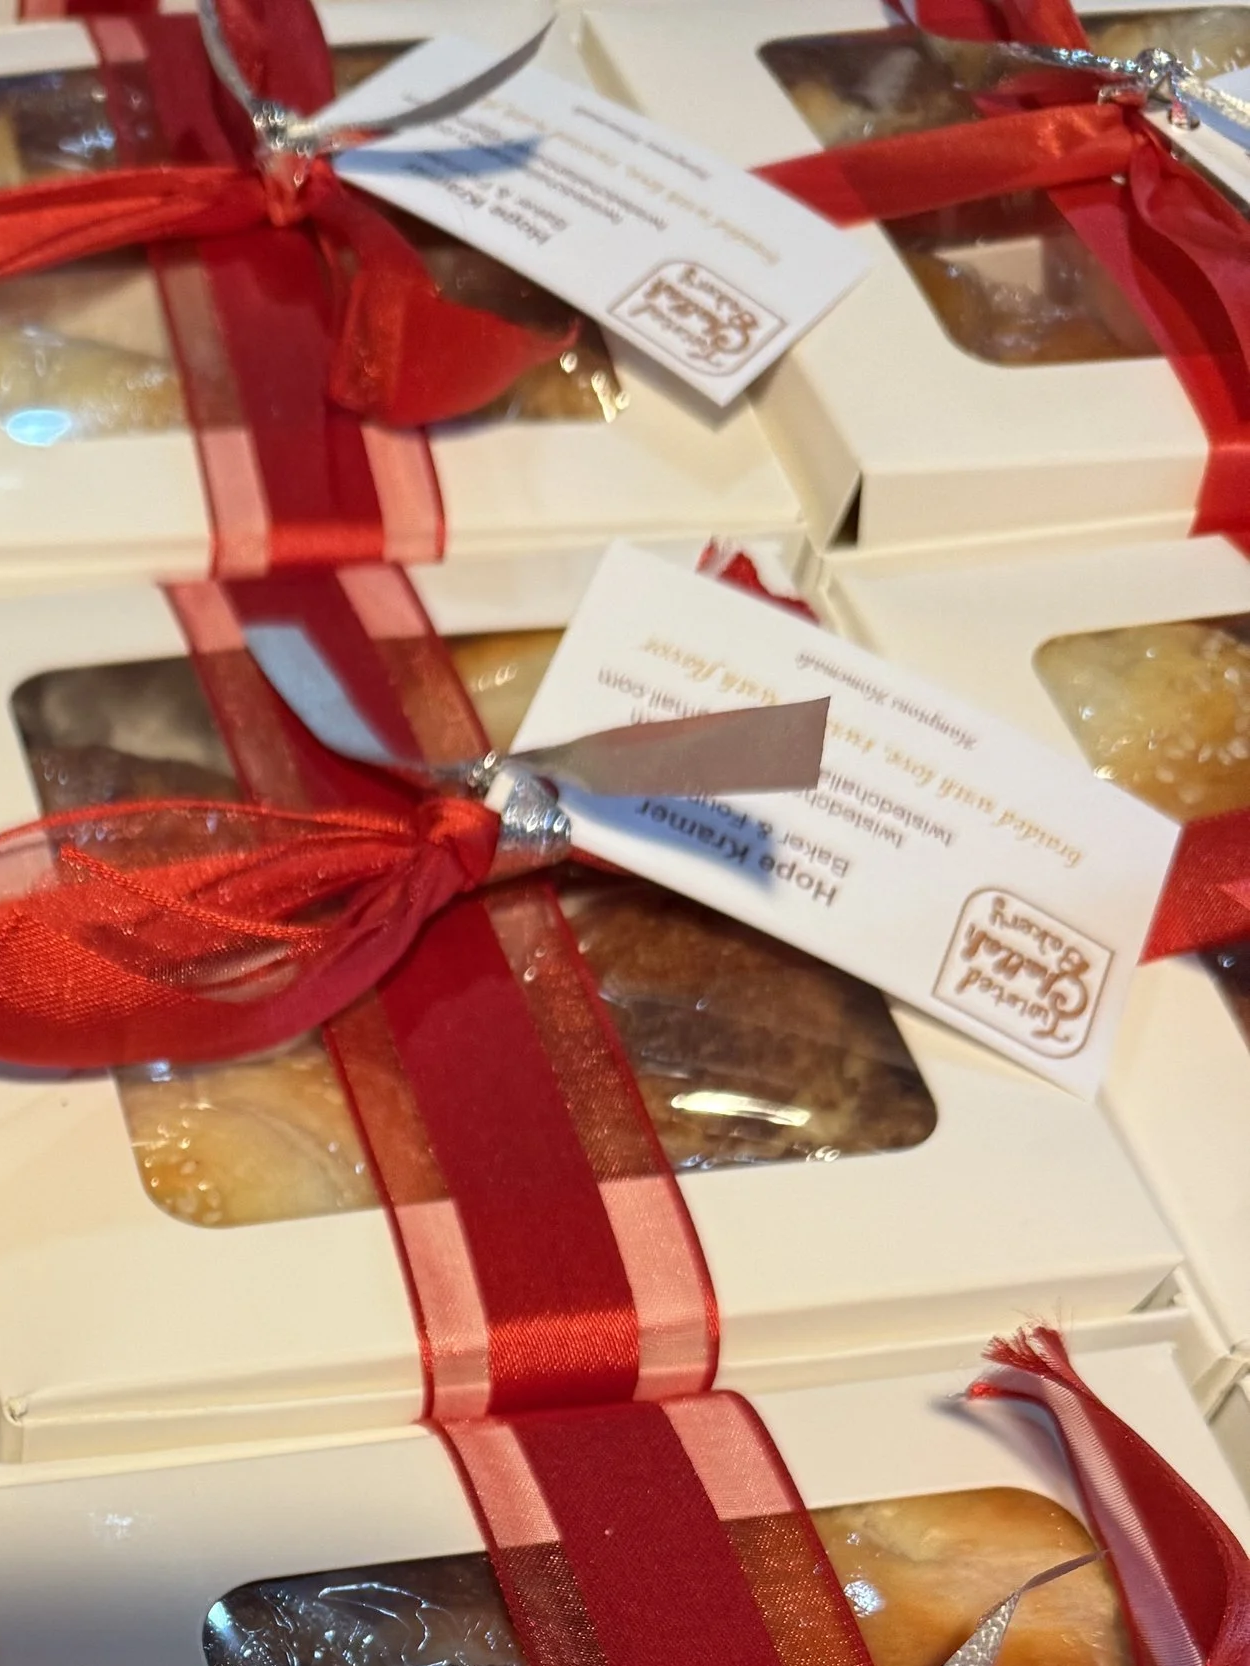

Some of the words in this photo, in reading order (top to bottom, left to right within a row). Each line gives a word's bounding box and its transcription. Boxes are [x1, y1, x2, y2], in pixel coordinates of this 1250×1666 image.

[635, 797, 759, 875] Kramer
[751, 820, 773, 846] &
[778, 830, 854, 879] Baker
[756, 851, 842, 909] Hope
[960, 922, 1090, 1020] Challah
[987, 895, 1090, 977] Bakery
[955, 966, 1070, 1043] Twisted
